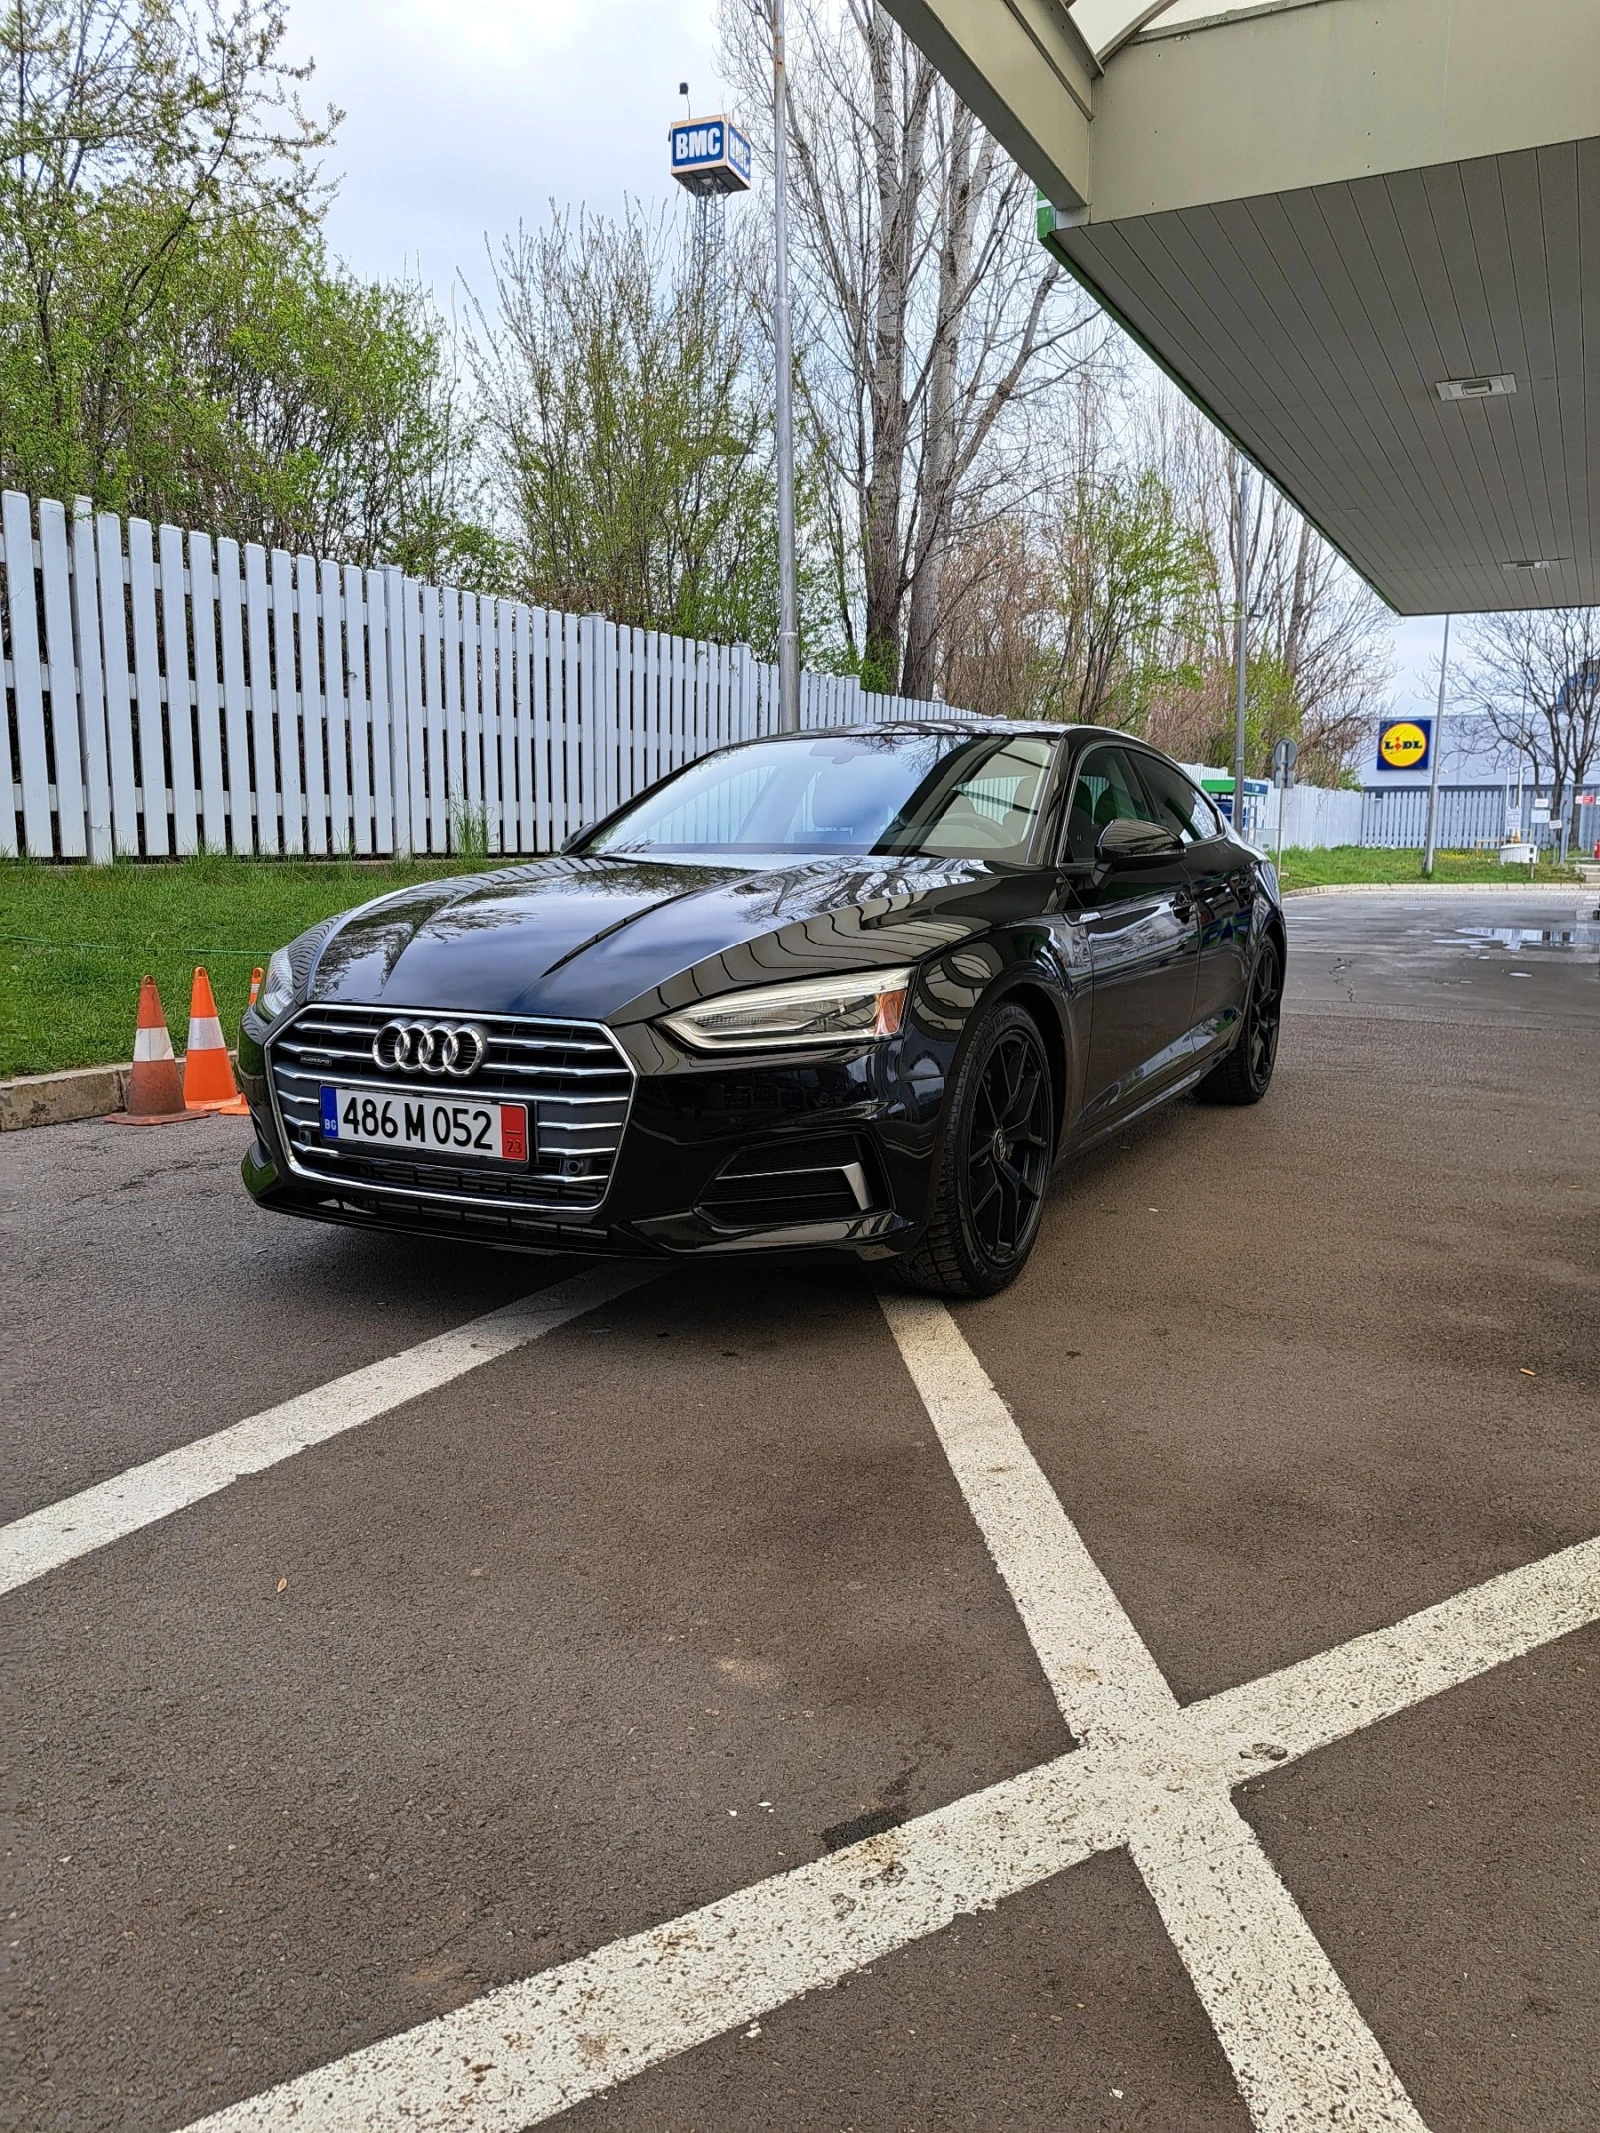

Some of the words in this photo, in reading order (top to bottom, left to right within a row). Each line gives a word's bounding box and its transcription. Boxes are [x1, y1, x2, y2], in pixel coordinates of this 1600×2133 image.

[676, 127, 721, 160] BMC
[730, 130, 750, 174] BMC
[324, 1118, 337, 1130] BG
[343, 1097, 398, 1138] 486
[404, 1102, 426, 1142] M
[433, 1106, 493, 1150] 052
[507, 1139, 521, 1153] 23
